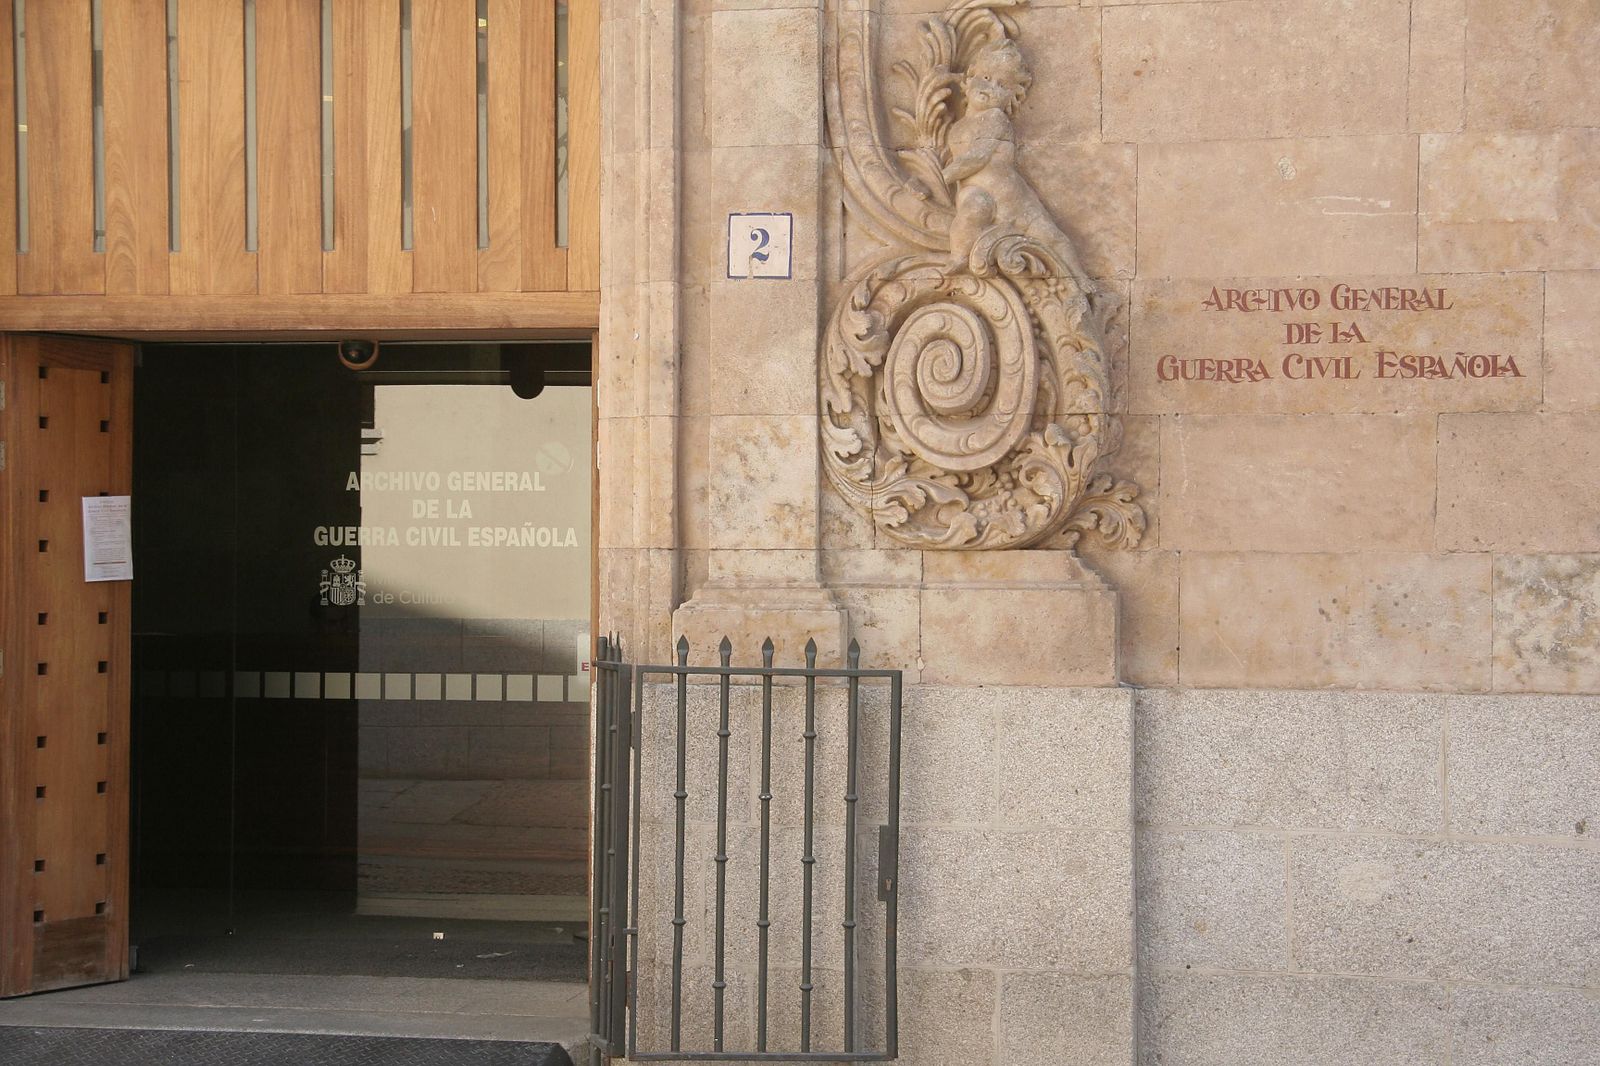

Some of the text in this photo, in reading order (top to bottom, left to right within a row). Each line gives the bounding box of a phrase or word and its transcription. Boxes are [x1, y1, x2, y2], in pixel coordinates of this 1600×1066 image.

[750, 227, 770, 262] 2
[1201, 283, 1454, 312] ARCHIVO GENERAL
[1282, 321, 1372, 345] DE LA
[1156, 351, 1528, 384] GUERRA CIVIL ESPAÑOLA
[345, 471, 546, 492] ARCHIVO GENERAL
[412, 499, 473, 519] DE LA
[313, 522, 579, 548] GUERRA CIVIL ESPAÑOLA
[373, 589, 394, 605] de
